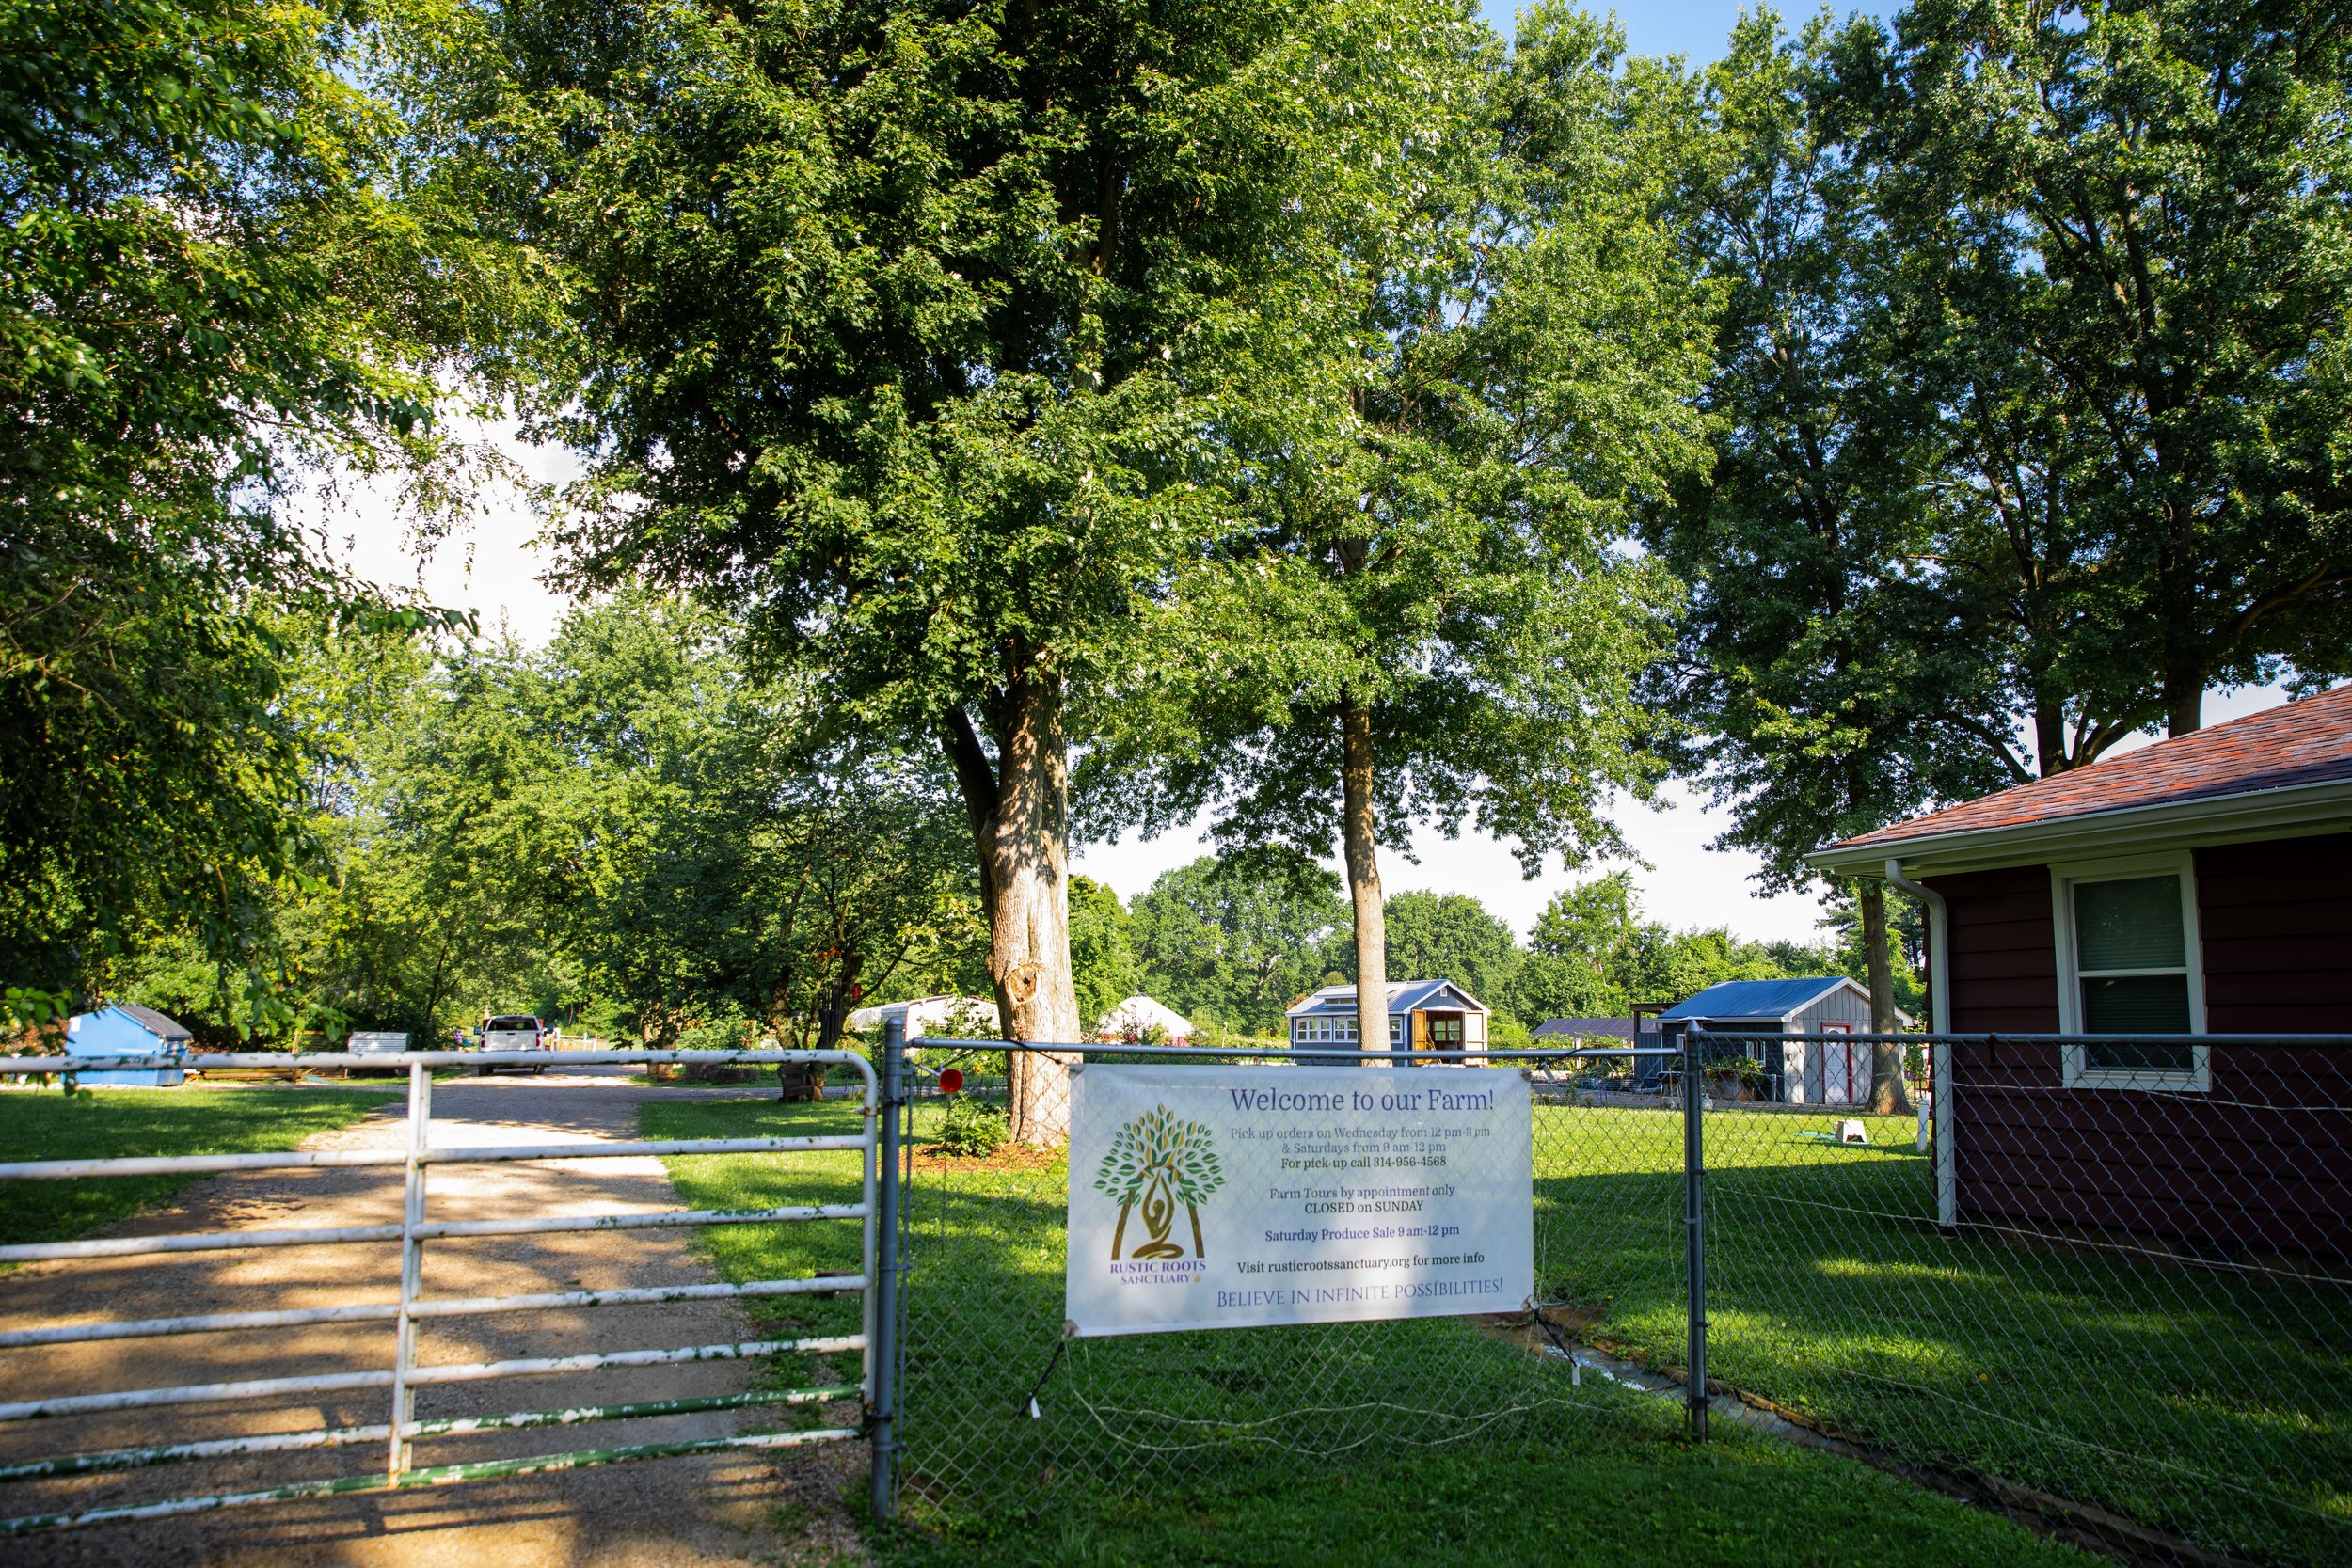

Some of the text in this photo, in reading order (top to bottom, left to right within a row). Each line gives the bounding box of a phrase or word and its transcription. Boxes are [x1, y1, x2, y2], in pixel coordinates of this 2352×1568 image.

[1230, 1087, 1494, 1111] Welcome to our Farm!
[1231, 1127, 1490, 1141] Pick up orders on Wednesday from 12 pm-3 pm
[1281, 1142, 1446, 1155] & Saturdays from 9 am-12 pm
[1281, 1156, 1446, 1170] For pick-up call 314-956-4568
[1269, 1183, 1454, 1199] Farm Tours by appointment only
[1304, 1200, 1424, 1214] CLOSED on SUNDAY
[1265, 1225, 1460, 1243] Saturday Produce Sale 9 am-12 pm
[1110, 1260, 1207, 1274] RUSTIC ROOTS
[1237, 1252, 1485, 1274] Visit rusticrootssanctuary.org for more info
[1120, 1274, 1191, 1285] SANCTUARY
[1217, 1276, 1503, 1307] BELIEVE IN INFINITE POSSIBILITIES!
